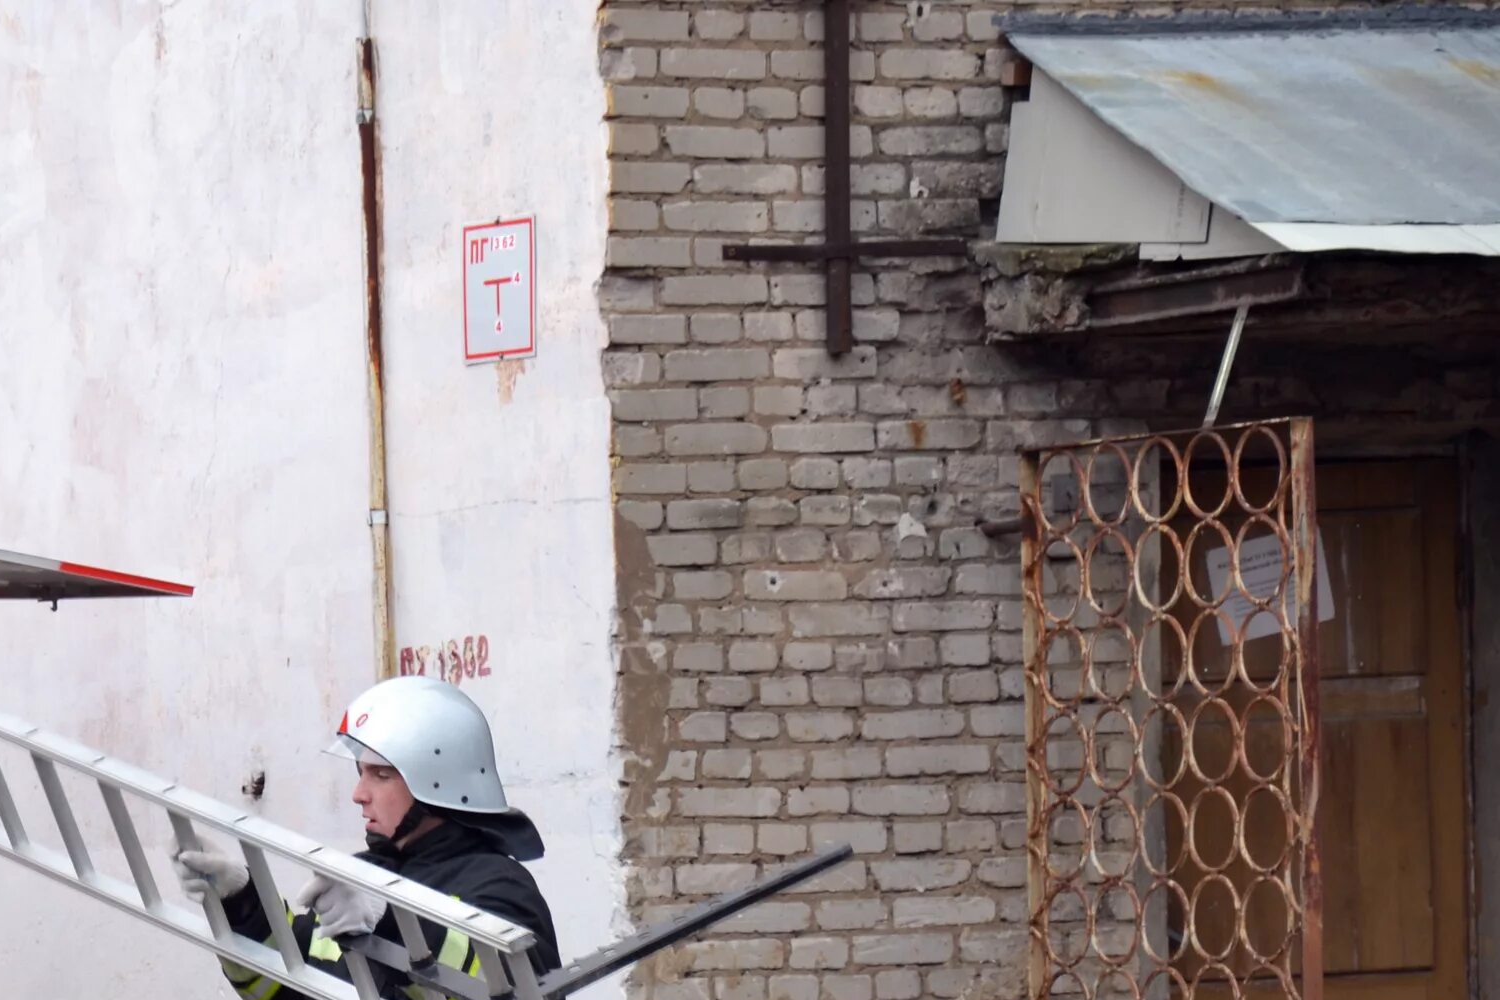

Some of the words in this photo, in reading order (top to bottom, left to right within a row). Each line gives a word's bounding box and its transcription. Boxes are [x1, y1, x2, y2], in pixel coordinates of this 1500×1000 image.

[471, 237, 489, 264] ПГ
[514, 272, 520, 283] 4
[496, 321, 502, 331] 4
